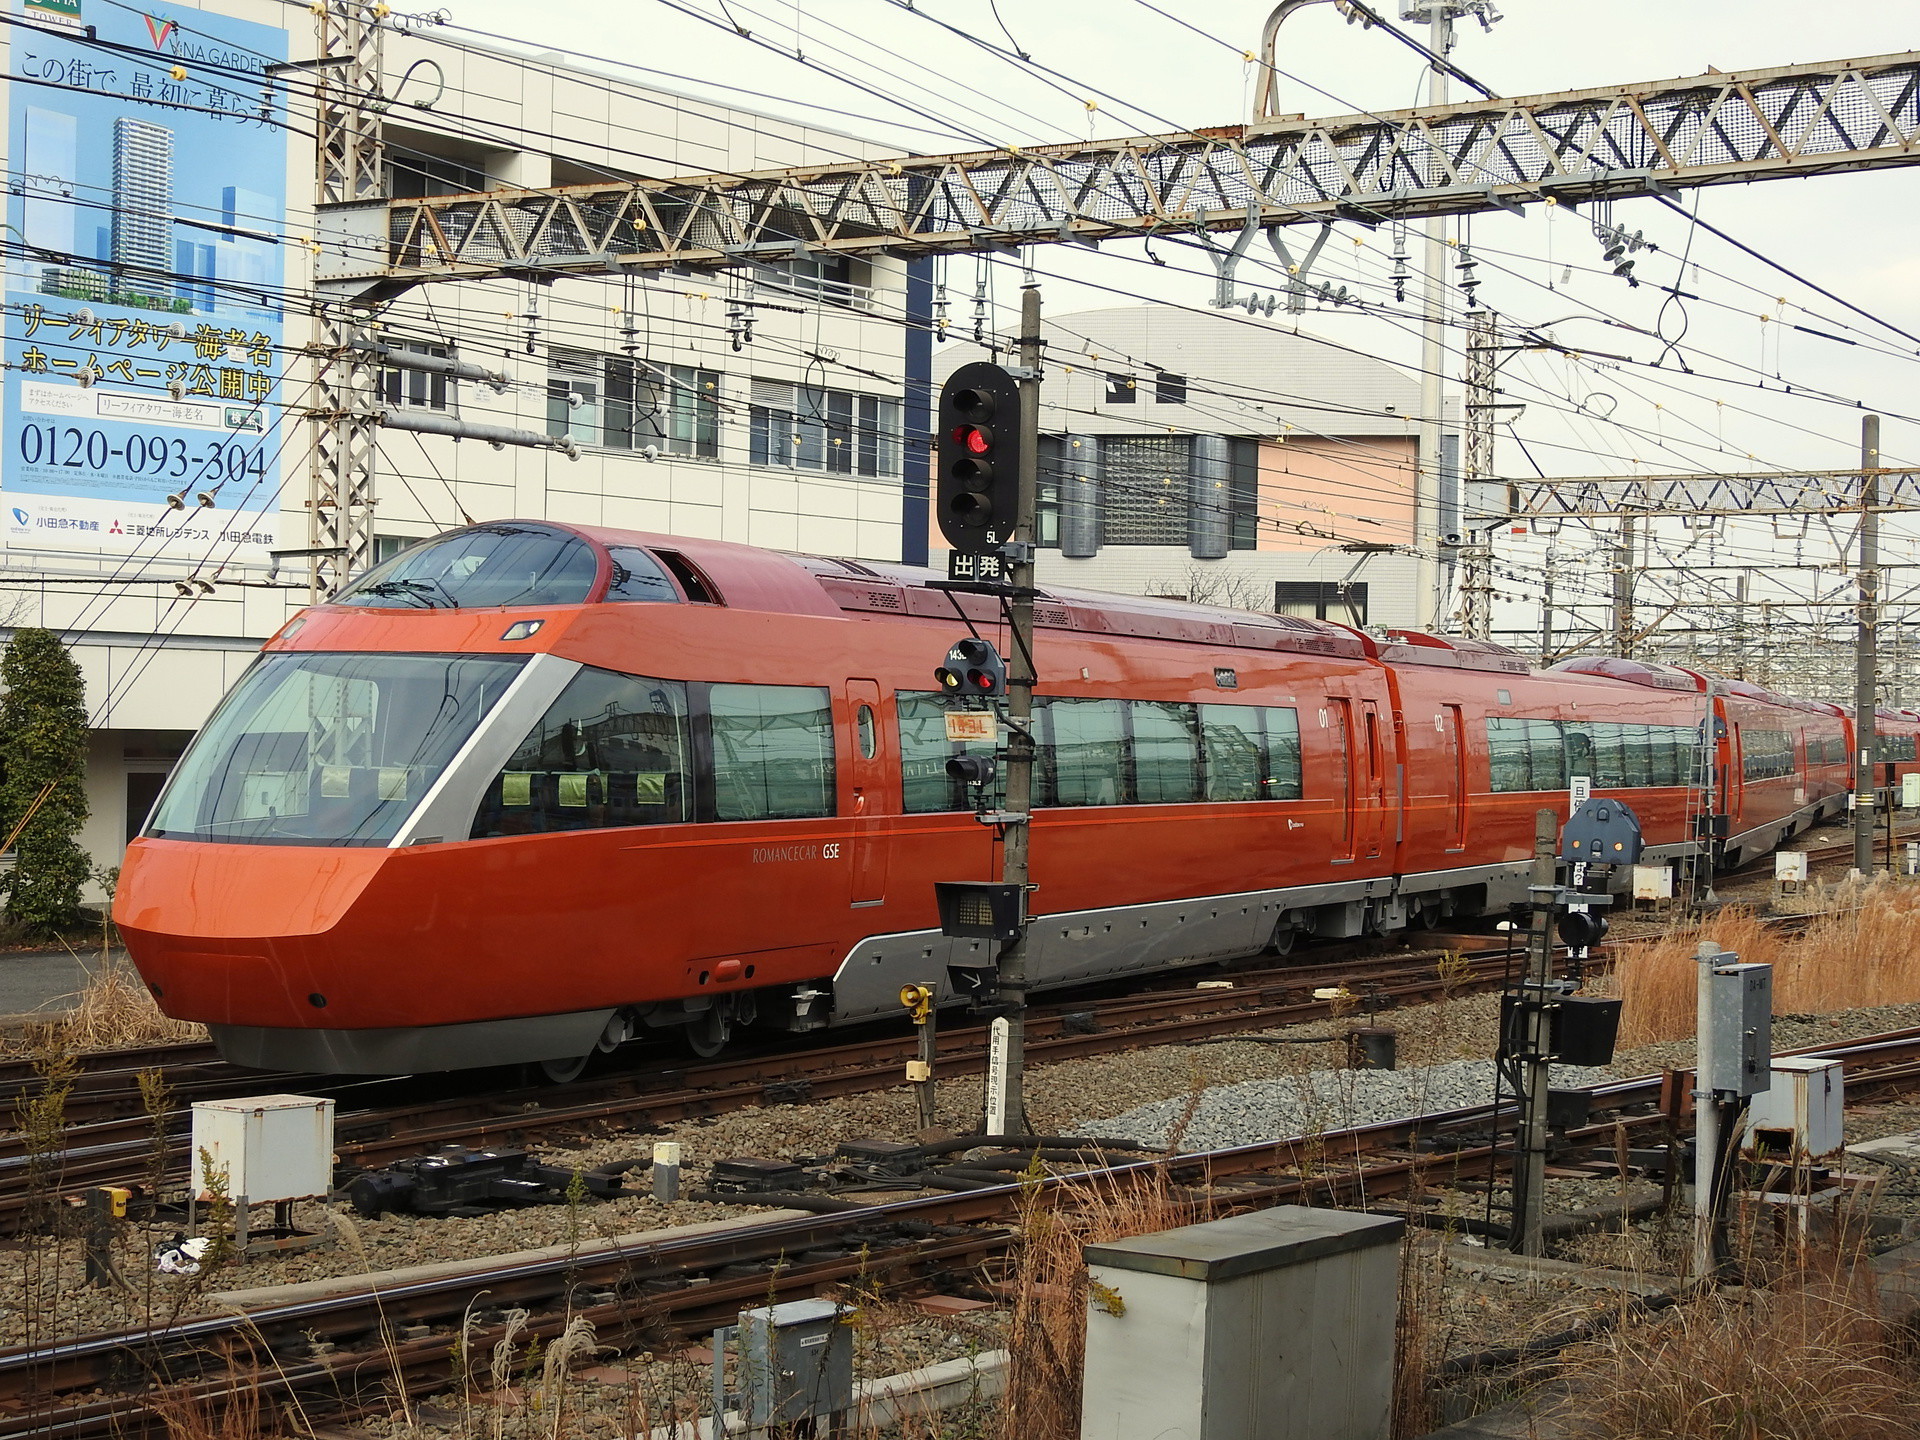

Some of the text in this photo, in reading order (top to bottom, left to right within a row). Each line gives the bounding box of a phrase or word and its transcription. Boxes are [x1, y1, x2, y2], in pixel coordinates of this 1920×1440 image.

[22, 346, 272, 403] ホームページ公開中
[103, 398, 204, 421] リーフィアタワー海老名
[20, 423, 267, 484] 0120-093-304
[36, 517, 99, 531] 小田急不動産
[220, 530, 274, 544] 小田急電鉄
[986, 531, 999, 544] 5L
[954, 555, 1000, 577] 出発
[1318, 708, 1329, 728] 01
[1434, 714, 1444, 732] 02
[753, 843, 840, 864] ROMANCECAR GSE
